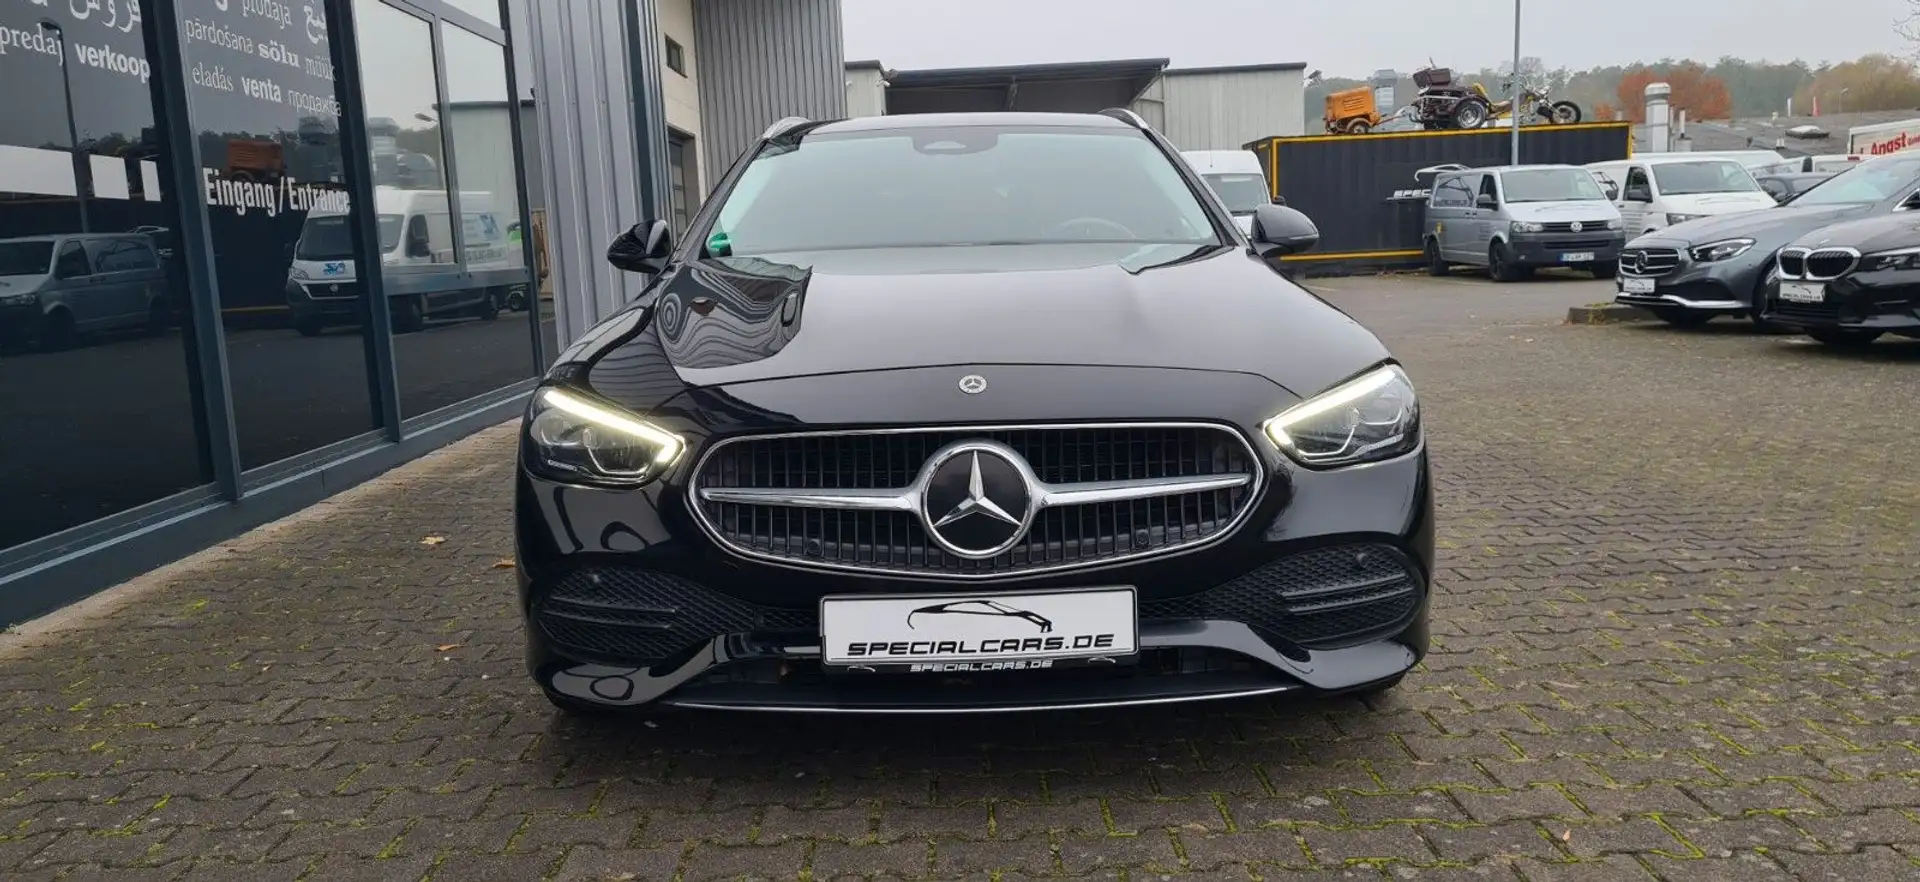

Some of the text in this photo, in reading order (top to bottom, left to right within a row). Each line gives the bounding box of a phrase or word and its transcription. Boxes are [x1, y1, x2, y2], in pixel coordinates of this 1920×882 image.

[0, 22, 151, 83] predaj verkoop
[257, 39, 300, 68] sölu
[192, 61, 234, 93] eladás
[241, 76, 282, 104] venta
[847, 633, 1115, 657] SPECIALCARS.DE
[909, 659, 1053, 673] SPECIALCARS.DE
